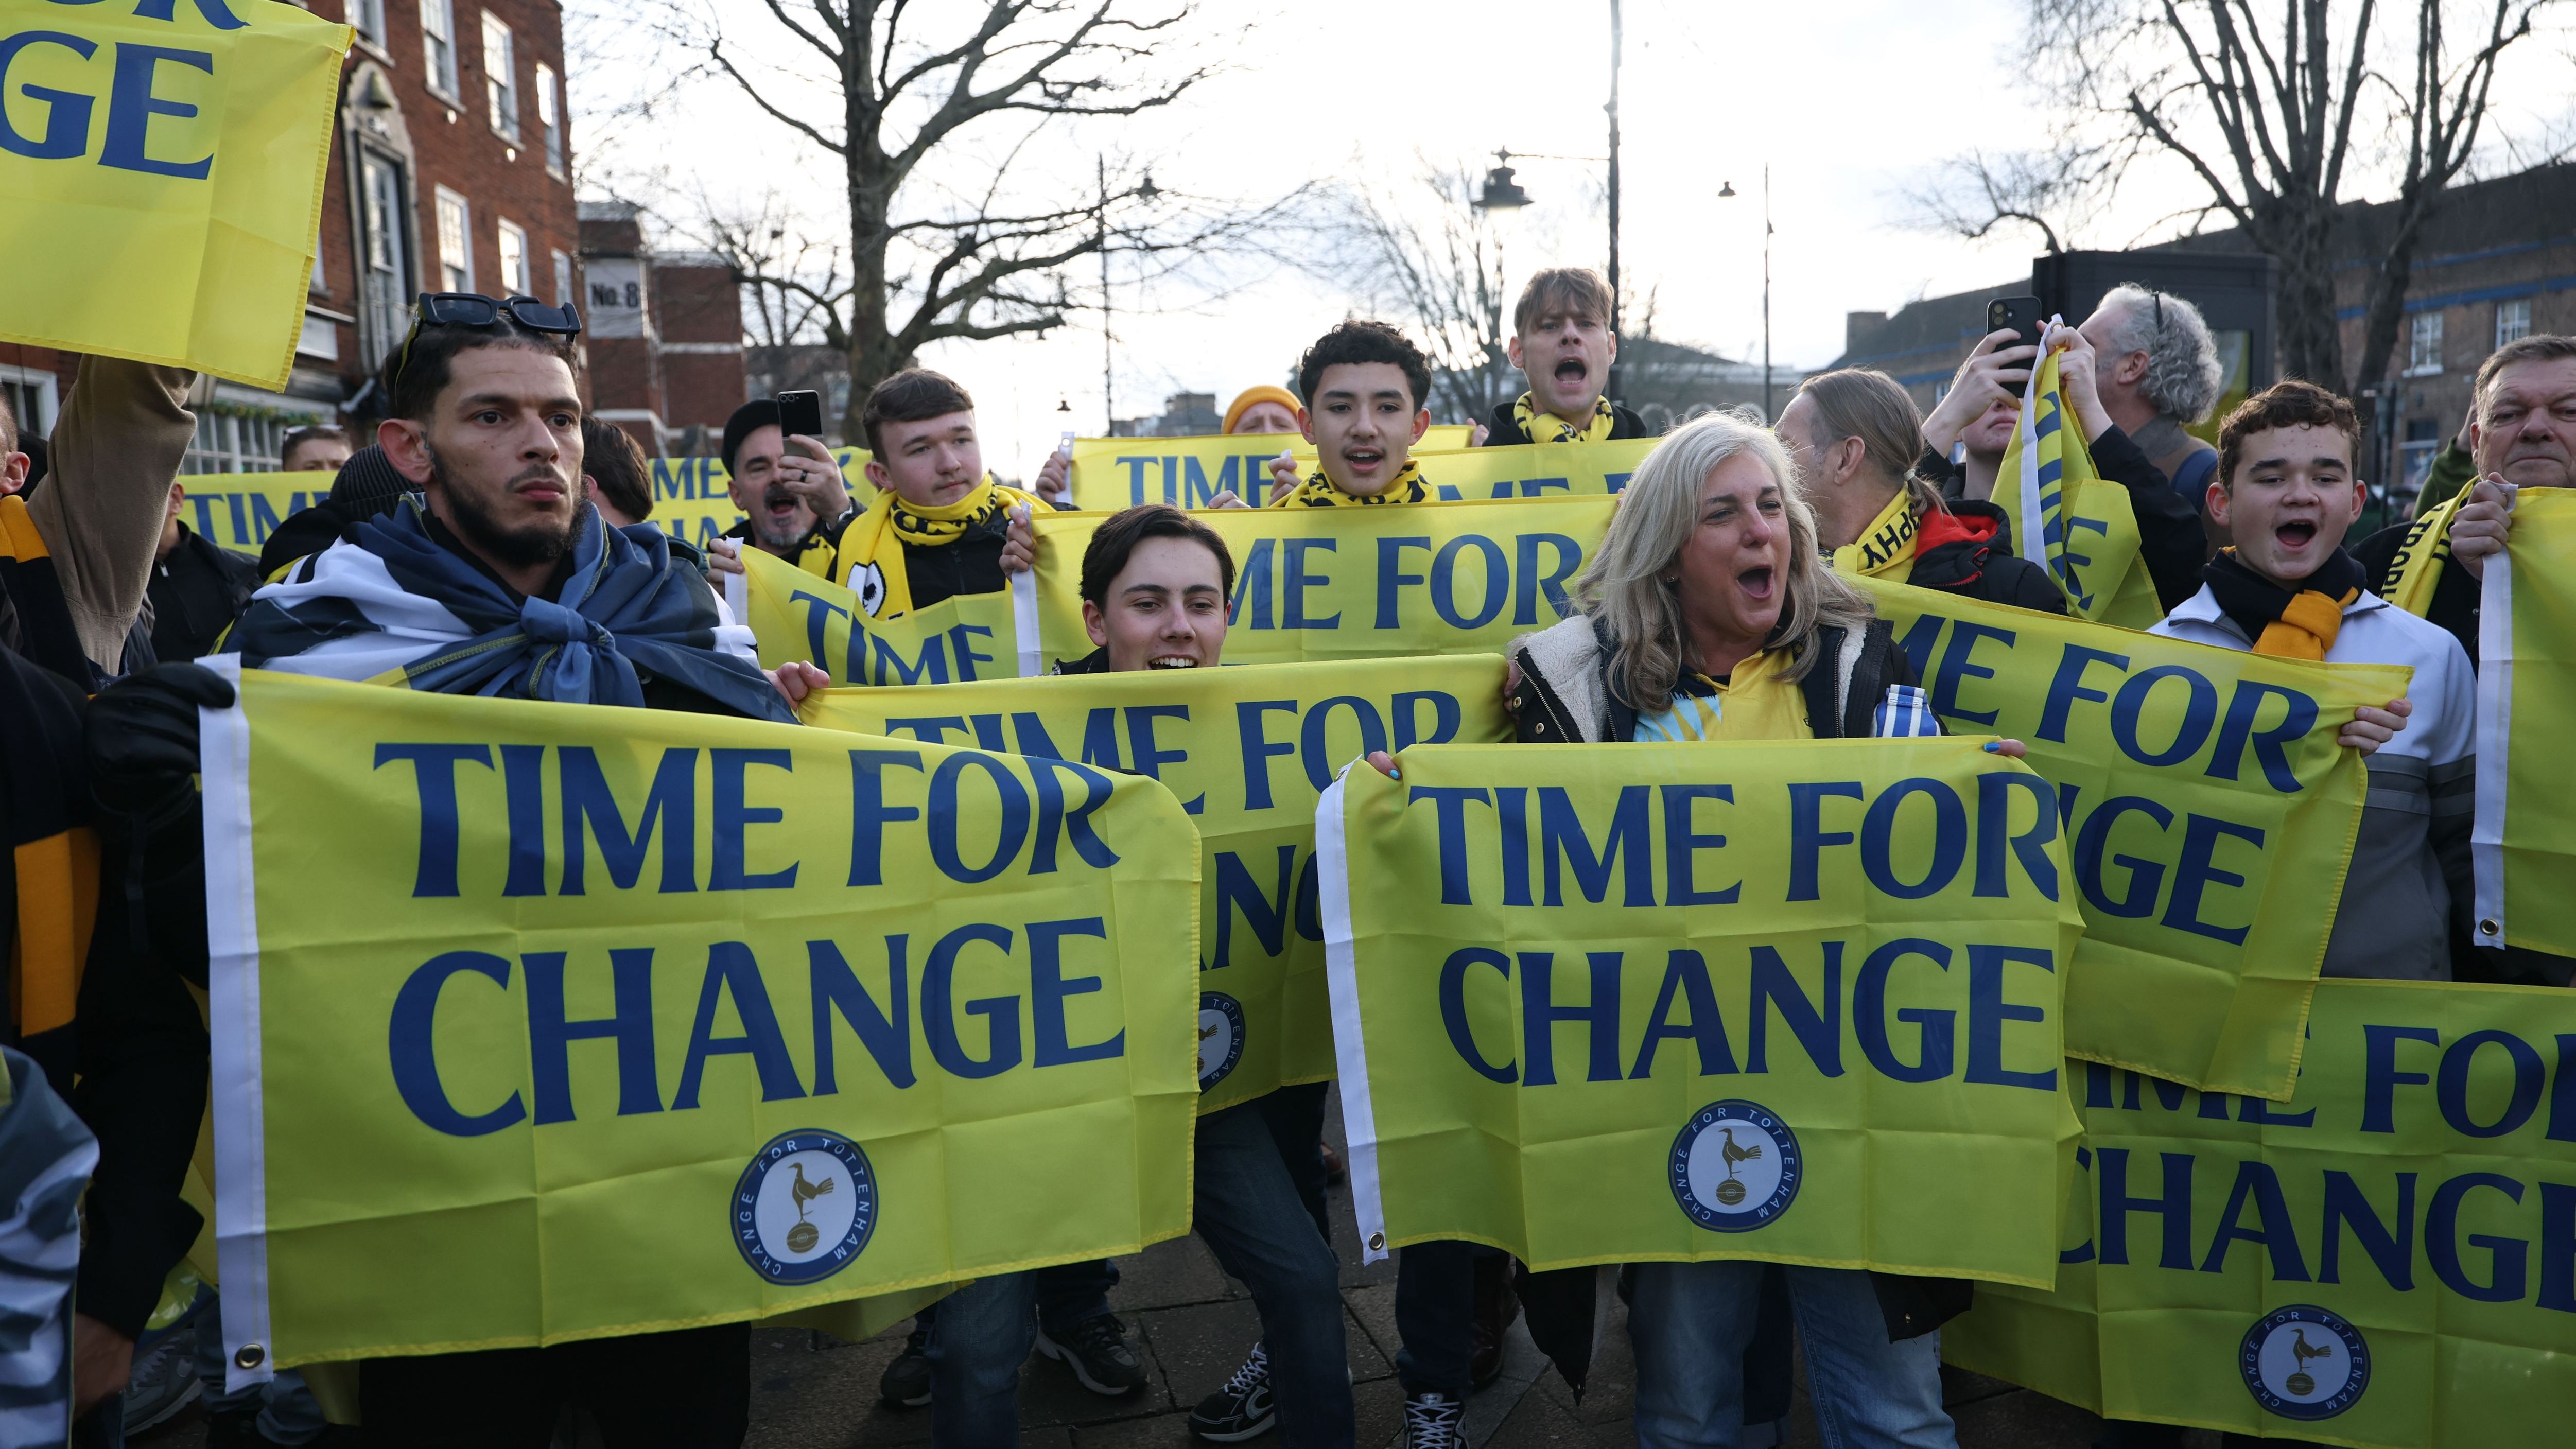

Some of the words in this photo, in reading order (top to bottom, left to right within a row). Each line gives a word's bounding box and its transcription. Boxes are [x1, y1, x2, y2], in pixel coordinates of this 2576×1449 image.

[626, 282, 638, 308] 8
[184, 491, 332, 545] TIM
[652, 457, 729, 501] ME
[1862, 503, 1922, 569] OPHY
[1228, 538, 1342, 630] ME
[1374, 534, 1582, 630] FOR
[2035, 643, 2319, 793] FOR
[374, 743, 800, 898] TIME
[847, 749, 1121, 886] FOR
[1408, 784, 1743, 907] TIME
[1786, 772, 2060, 903] FOR
[389, 917, 1125, 1137] CHANGE
[1211, 998, 1240, 1080] TOTTENHAM
[1439, 938, 2058, 1092] CHANGE
[759, 1140, 797, 1172] FOR
[1692, 1108, 1726, 1133] FOR
[1748, 1109, 1795, 1218] TOTTENHAM
[822, 1138, 870, 1260] TOTTENHAM
[1676, 1148, 1711, 1220] CHANGE
[739, 1192, 781, 1276] CHANGE
[2246, 1340, 2280, 1407] CHANGE
[2265, 1311, 2300, 1331] FOR
[2322, 1315, 2363, 1410] TOTTENHAM
